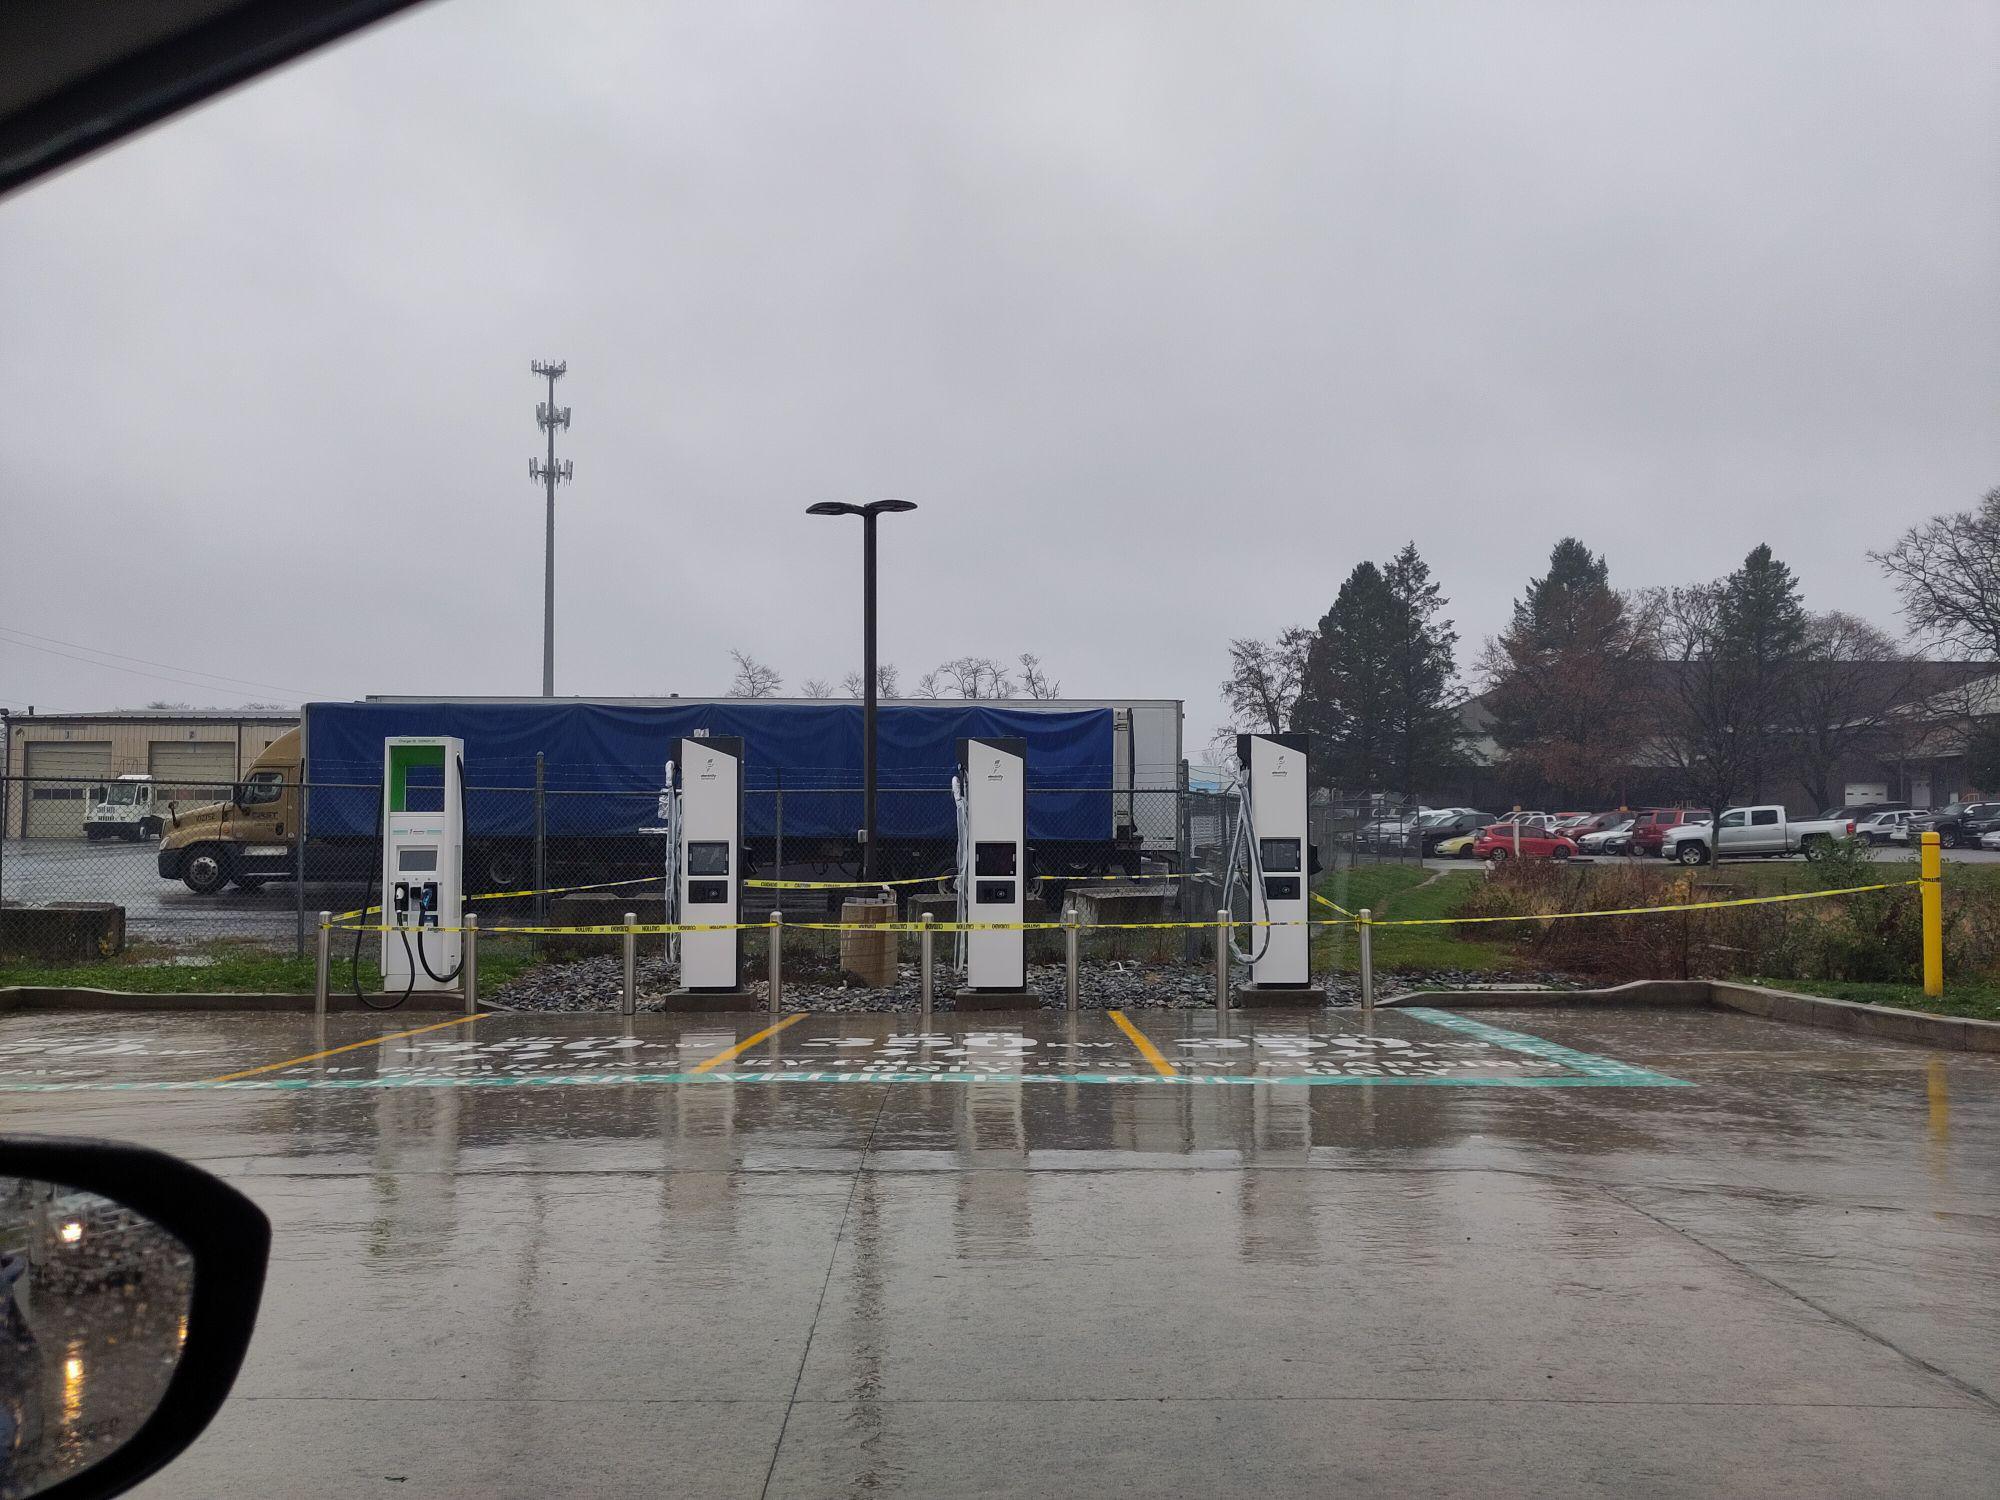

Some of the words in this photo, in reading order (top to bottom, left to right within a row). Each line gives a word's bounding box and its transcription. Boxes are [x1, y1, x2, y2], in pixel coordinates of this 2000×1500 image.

[396, 1039, 644, 1053] 350
[801, 1037, 1037, 1047] 350
[1173, 1038, 1411, 1049] 350
[376, 1060, 680, 1073] CHARGING
[862, 1065, 1013, 1073] ONLY
[1303, 1068, 1451, 1076] ONLY
[307, 1075, 669, 1088] ELECTRIC
[714, 1073, 1062, 1082] VEHICLES
[1107, 1076, 1280, 1084] ONLY
